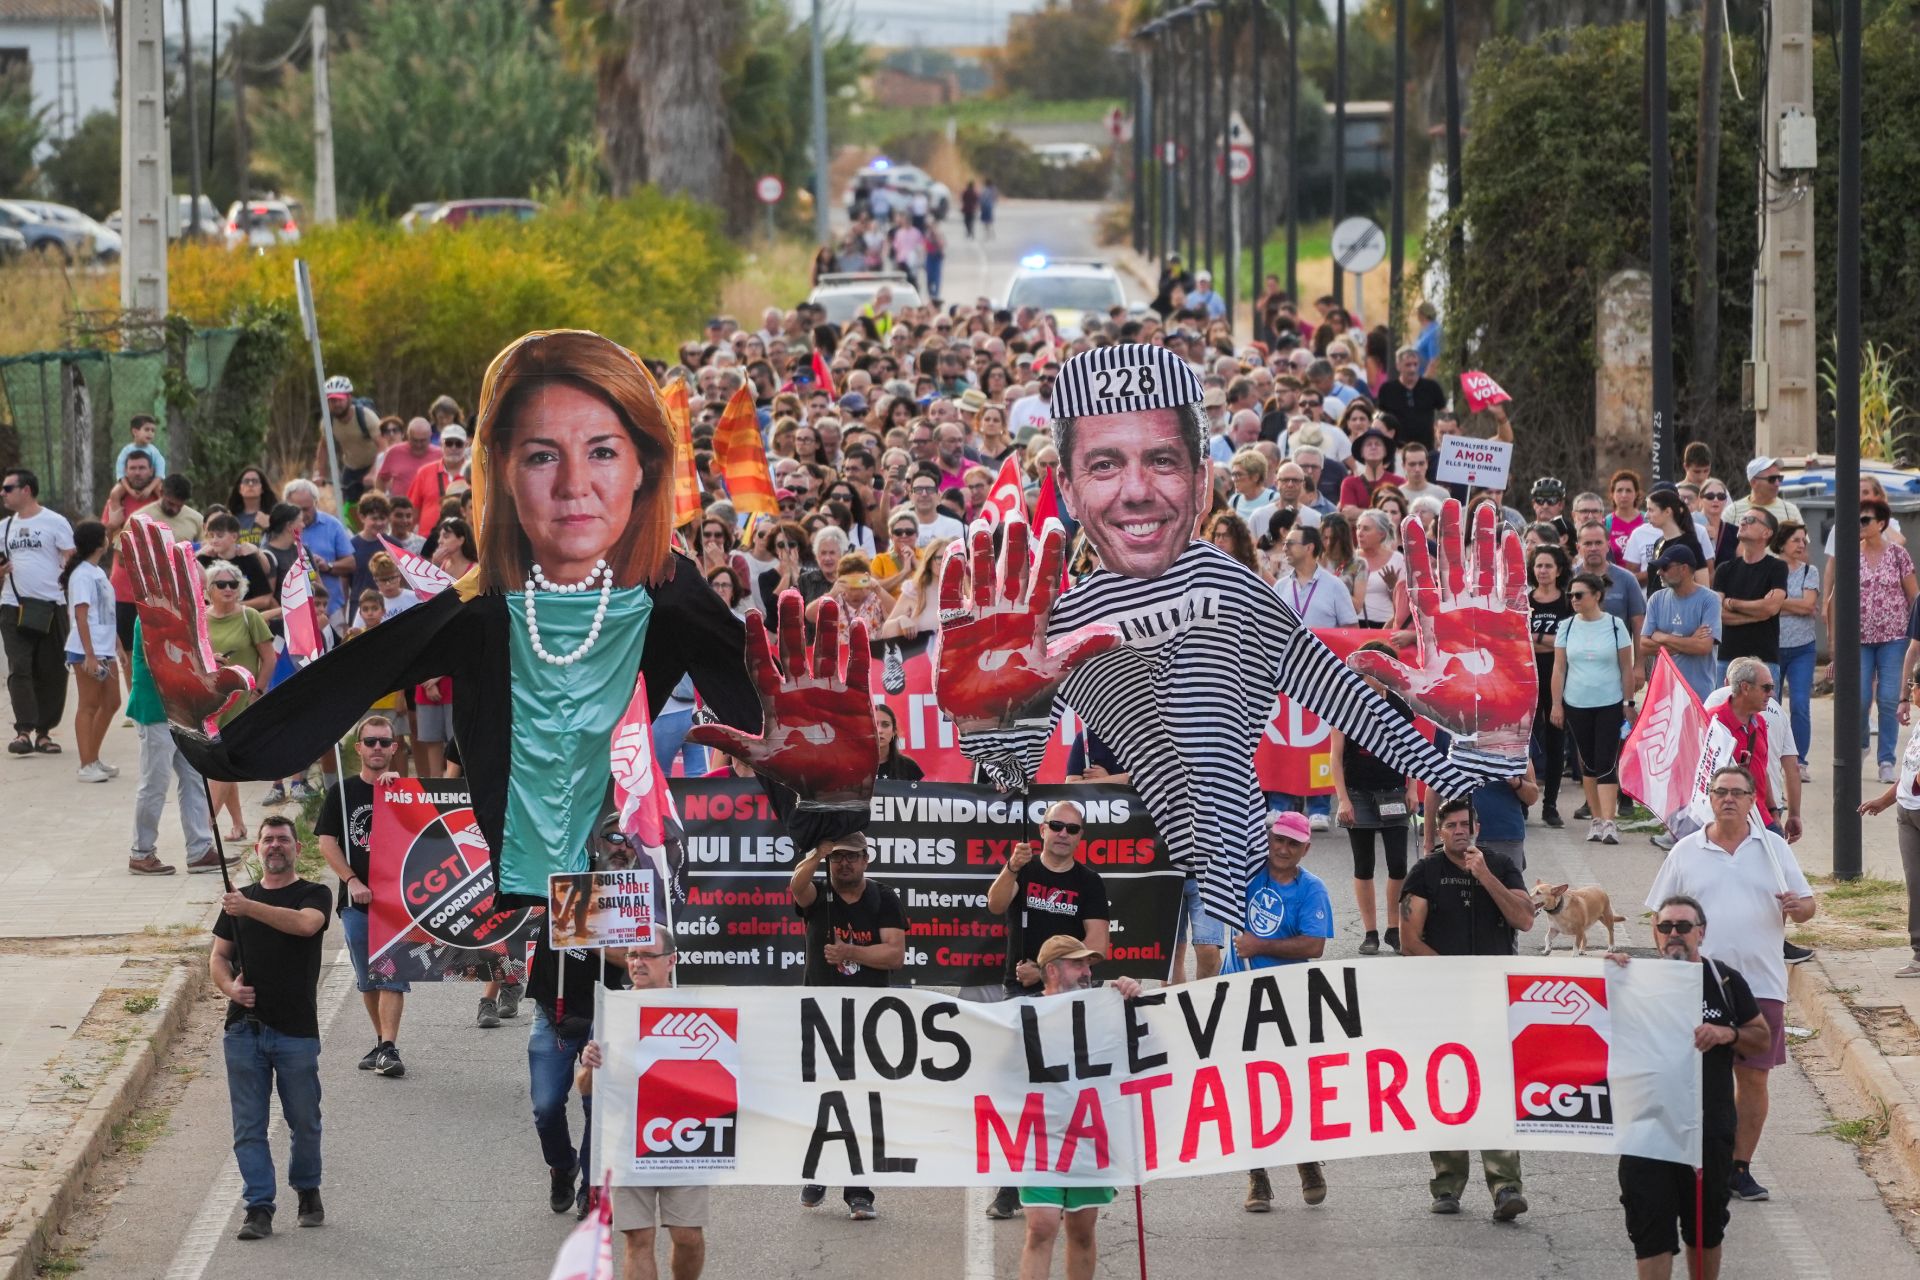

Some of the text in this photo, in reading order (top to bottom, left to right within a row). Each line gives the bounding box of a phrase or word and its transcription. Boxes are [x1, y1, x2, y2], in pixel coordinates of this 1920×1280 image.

[1096, 366, 1155, 398] 228
[1450, 441, 1489, 450] NOSALTRES
[1455, 449, 1494, 463] AMOR
[1477, 464, 1502, 472] DINERS
[384, 789, 472, 804] PAÍS VALENCI
[685, 794, 778, 820] NOST
[740, 836, 795, 863] LES
[406, 854, 464, 905] CGT
[597, 873, 637, 886] SOLS EL
[619, 882, 650, 894] POBLE
[598, 896, 646, 909] SALVA AL
[687, 887, 797, 906] Autonòmi
[908, 888, 989, 908] Interve
[448, 895, 495, 937] DEL TER
[620, 906, 650, 918] POBLE
[676, 916, 721, 935] ació
[727, 917, 806, 936] salaria
[905, 918, 1009, 937] ministra
[676, 941, 1166, 970] xement i pa de Carrer ional.
[801, 967, 1363, 1083] NOS LLEVAN
[802, 1042, 1481, 1179] AL MATADERO
[1521, 1082, 1608, 1118] CGT
[643, 1117, 733, 1152] CGT
